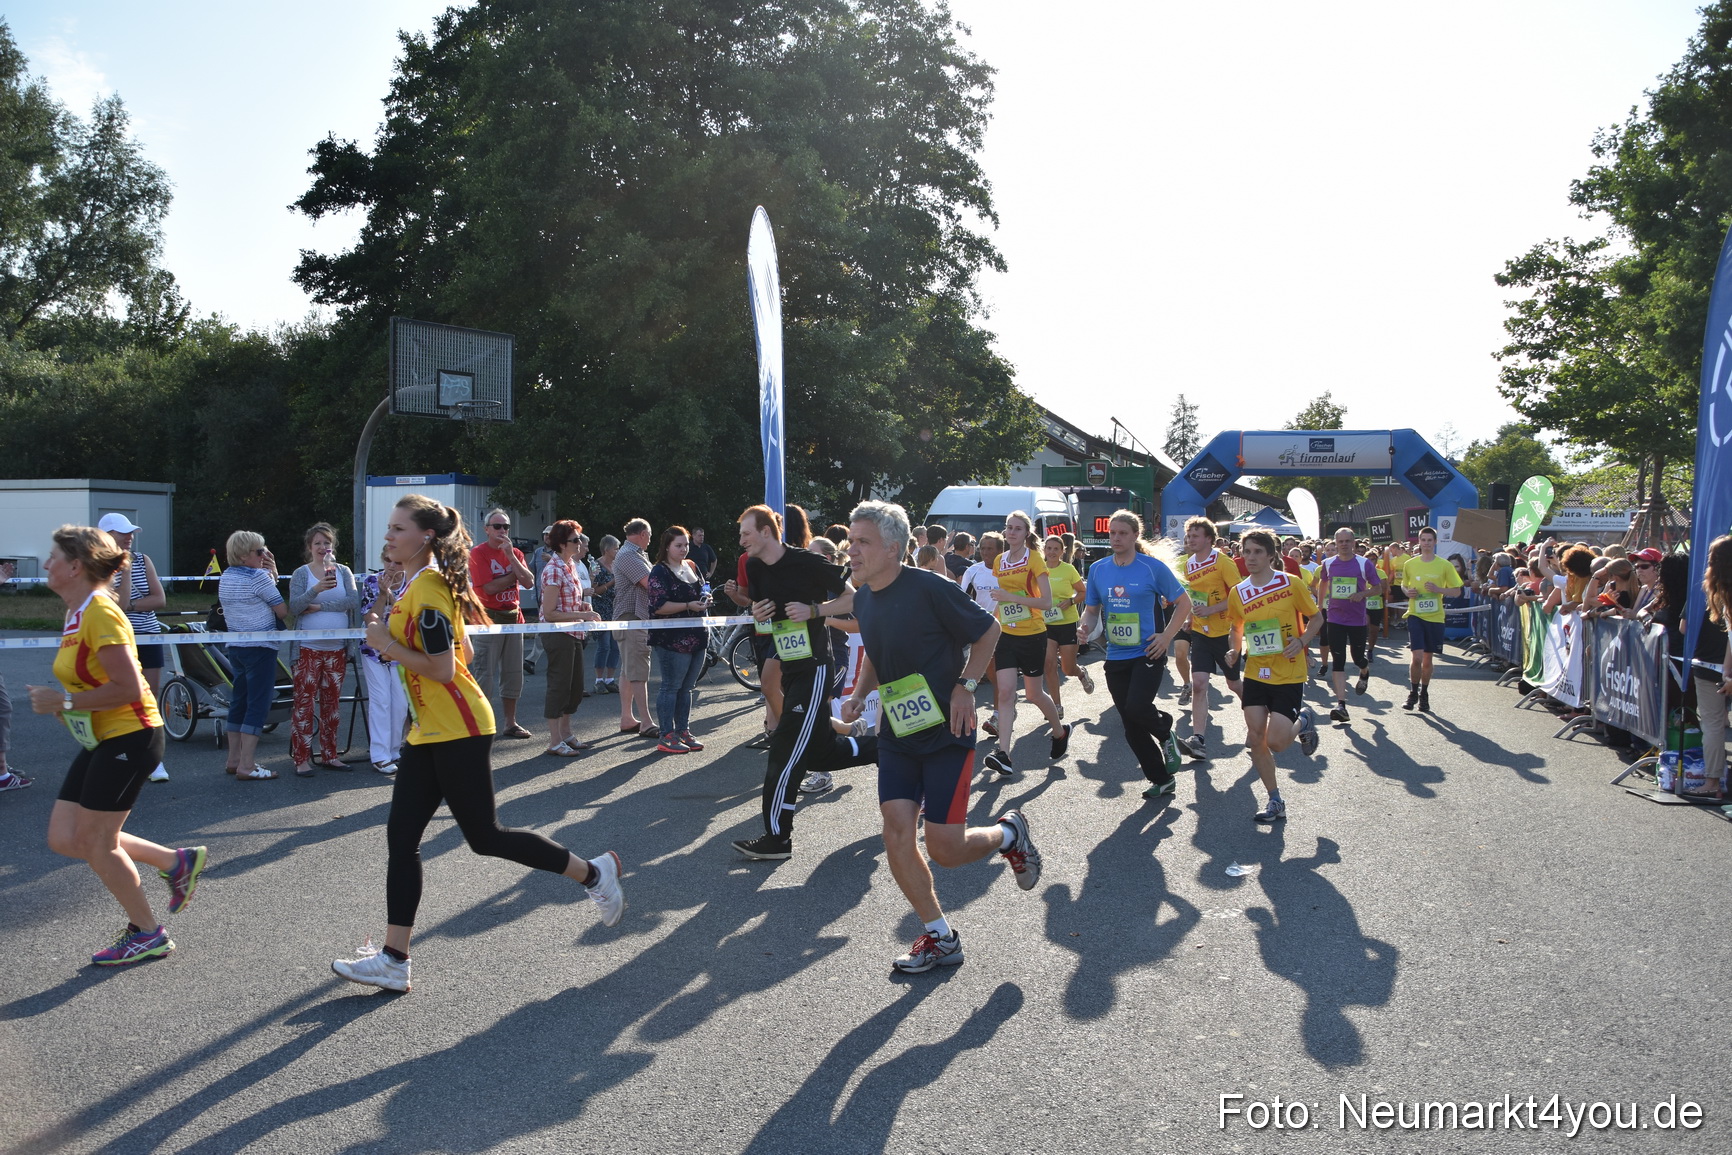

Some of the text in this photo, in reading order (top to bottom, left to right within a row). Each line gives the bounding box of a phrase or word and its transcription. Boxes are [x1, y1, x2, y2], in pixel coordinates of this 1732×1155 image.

[1300, 453, 1356, 463] firmenlauf
[1410, 515, 1426, 528] RW
[1512, 514, 1532, 536] AOK
[1371, 525, 1386, 535] RW
[1189, 566, 1218, 582] MAX BÖGL
[1336, 585, 1351, 593] 291
[1108, 597, 1130, 605] camping
[1243, 590, 1293, 615] MAX BÖGL
[1418, 600, 1434, 608] 650
[1003, 603, 1023, 616] 885
[1044, 608, 1058, 618] 664
[1111, 626, 1132, 637] 480
[777, 633, 806, 650] 1264
[1253, 633, 1275, 646] 917
[1605, 661, 1640, 699] Fischer
[890, 695, 931, 722] 1296
